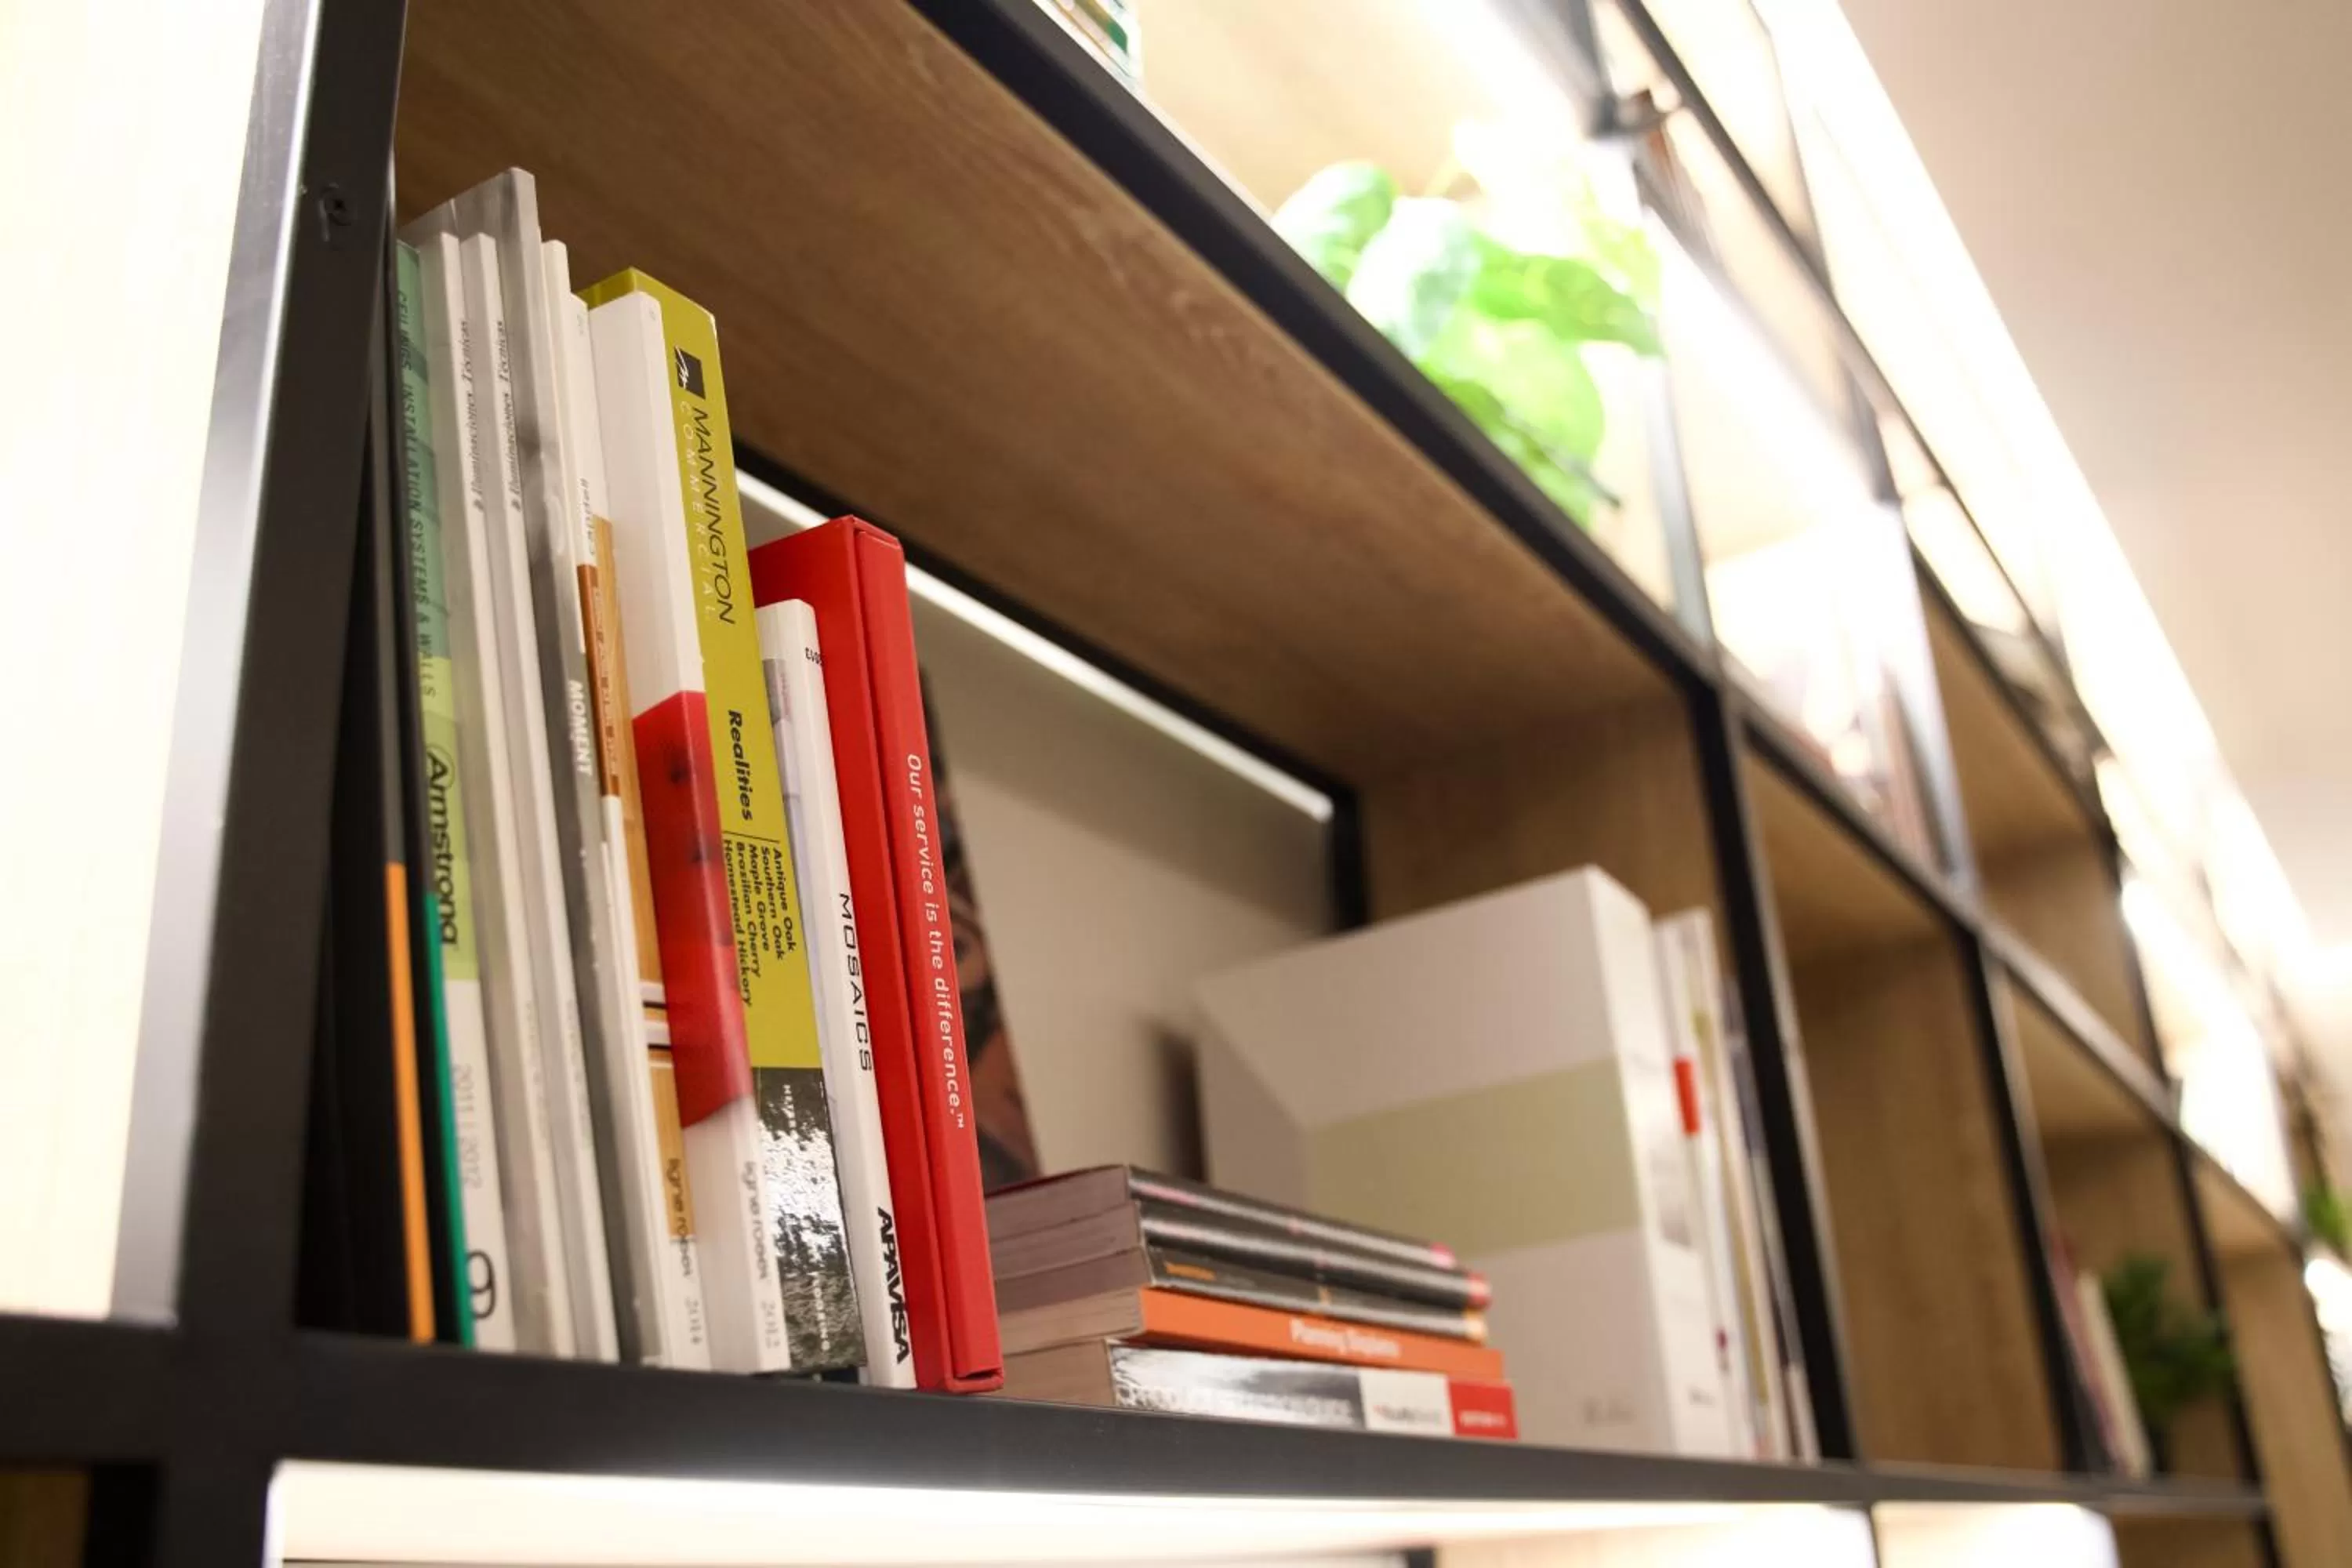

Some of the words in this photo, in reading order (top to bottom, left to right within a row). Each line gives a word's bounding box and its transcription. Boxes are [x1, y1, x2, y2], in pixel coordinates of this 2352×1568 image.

[403, 385, 422, 511] INSTALLATION
[680, 400, 716, 616] COMMERCIAL
[692, 406, 736, 625] MANNINGTON
[411, 519, 430, 605] SYSTEMS
[419, 632, 437, 699] WALLS
[568, 679, 593, 776] MOMENT
[728, 710, 753, 822] Realities
[907, 753, 923, 800] Our
[748, 844, 764, 896] Maple
[757, 902, 770, 952] Grove
[773, 847, 788, 912] Antique
[783, 916, 797, 952] Oak
[913, 805, 935, 895] service
[724, 839, 746, 935] Homestead
[737, 940, 753, 1008] Hickory
[746, 920, 761, 978] Cherry
[760, 846, 778, 920] Southern
[771, 925, 786, 961] Oak
[924, 902, 940, 923] is
[929, 930, 945, 970] the
[840, 892, 873, 1072] MOSAICS
[877, 1207, 910, 1365] APAVISA
